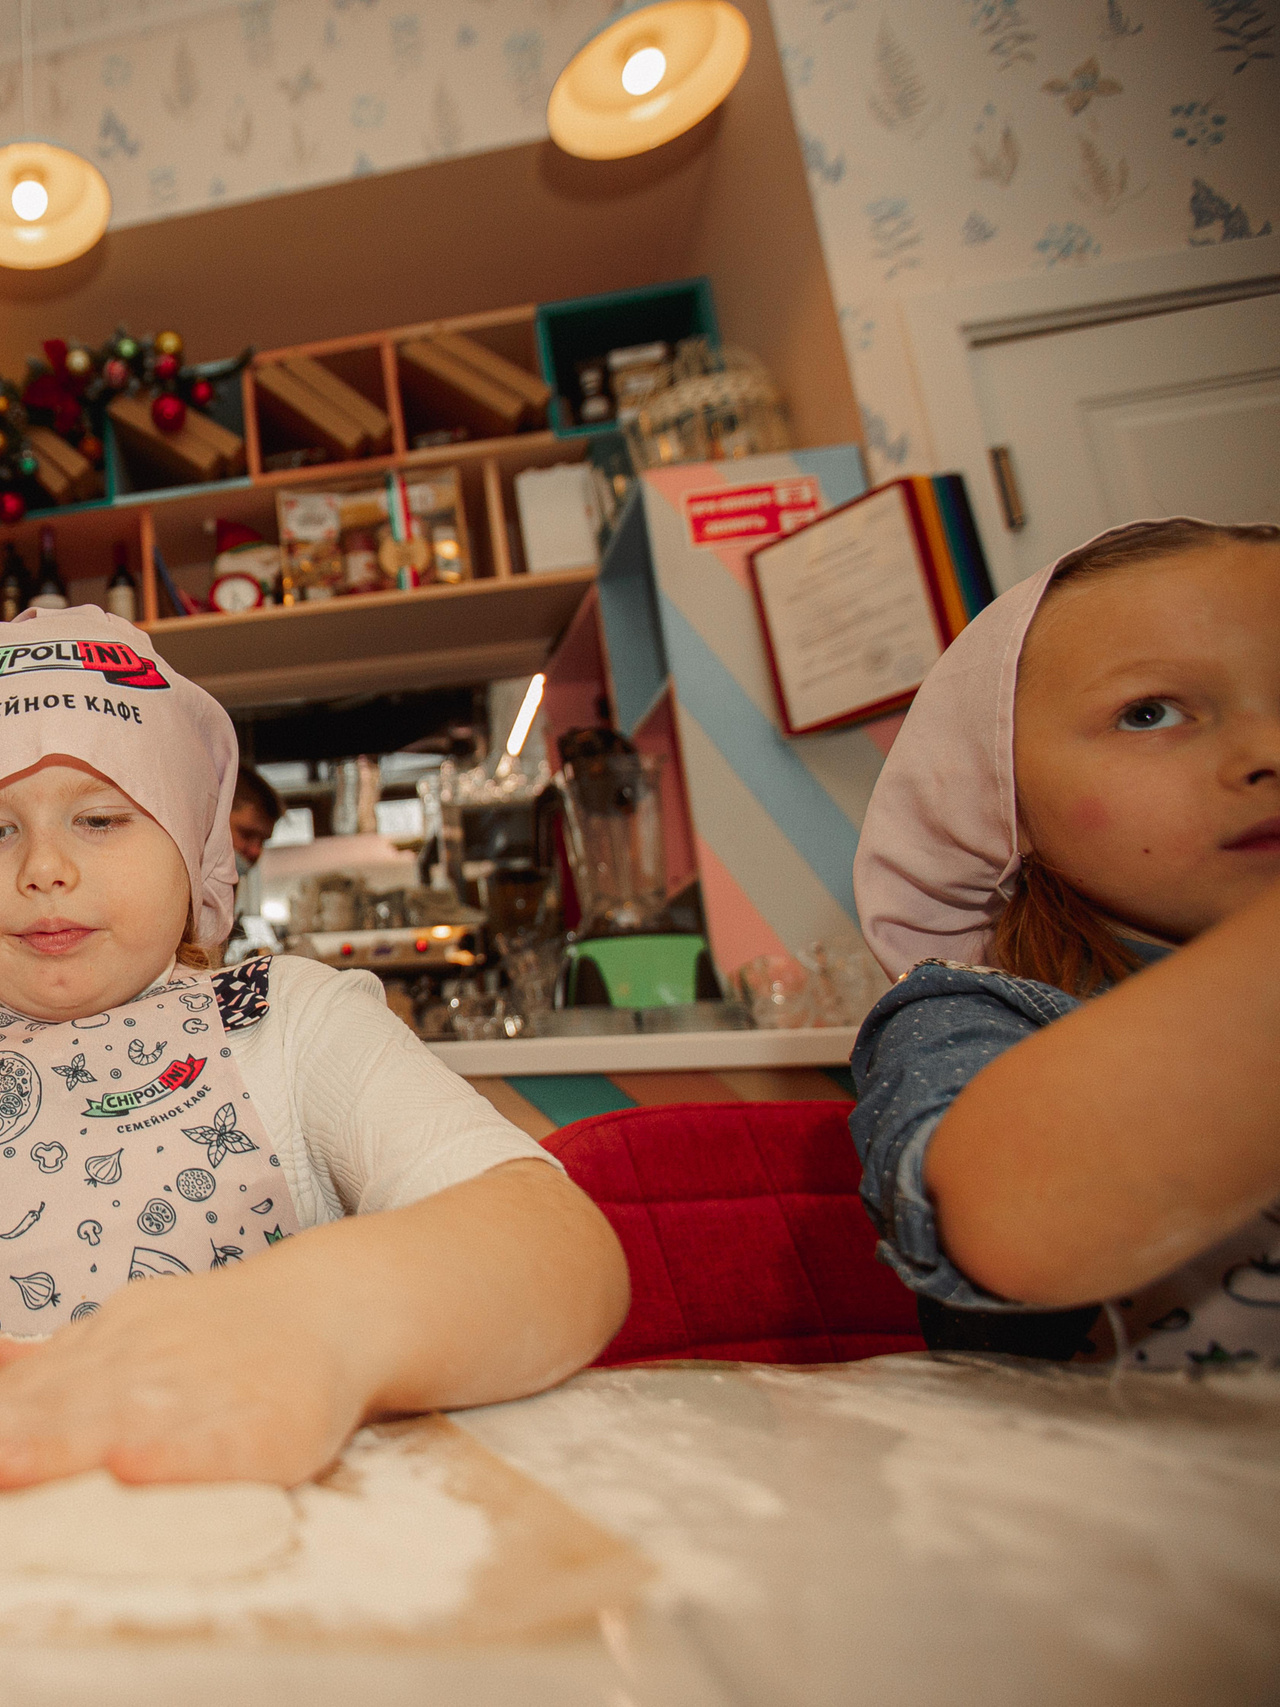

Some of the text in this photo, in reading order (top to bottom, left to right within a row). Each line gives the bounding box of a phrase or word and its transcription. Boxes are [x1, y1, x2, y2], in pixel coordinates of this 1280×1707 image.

[86, 695, 143, 724] КАФЕ
[116, 1085, 211, 1134] СЕМЕЙНОЕ КАФЕ
